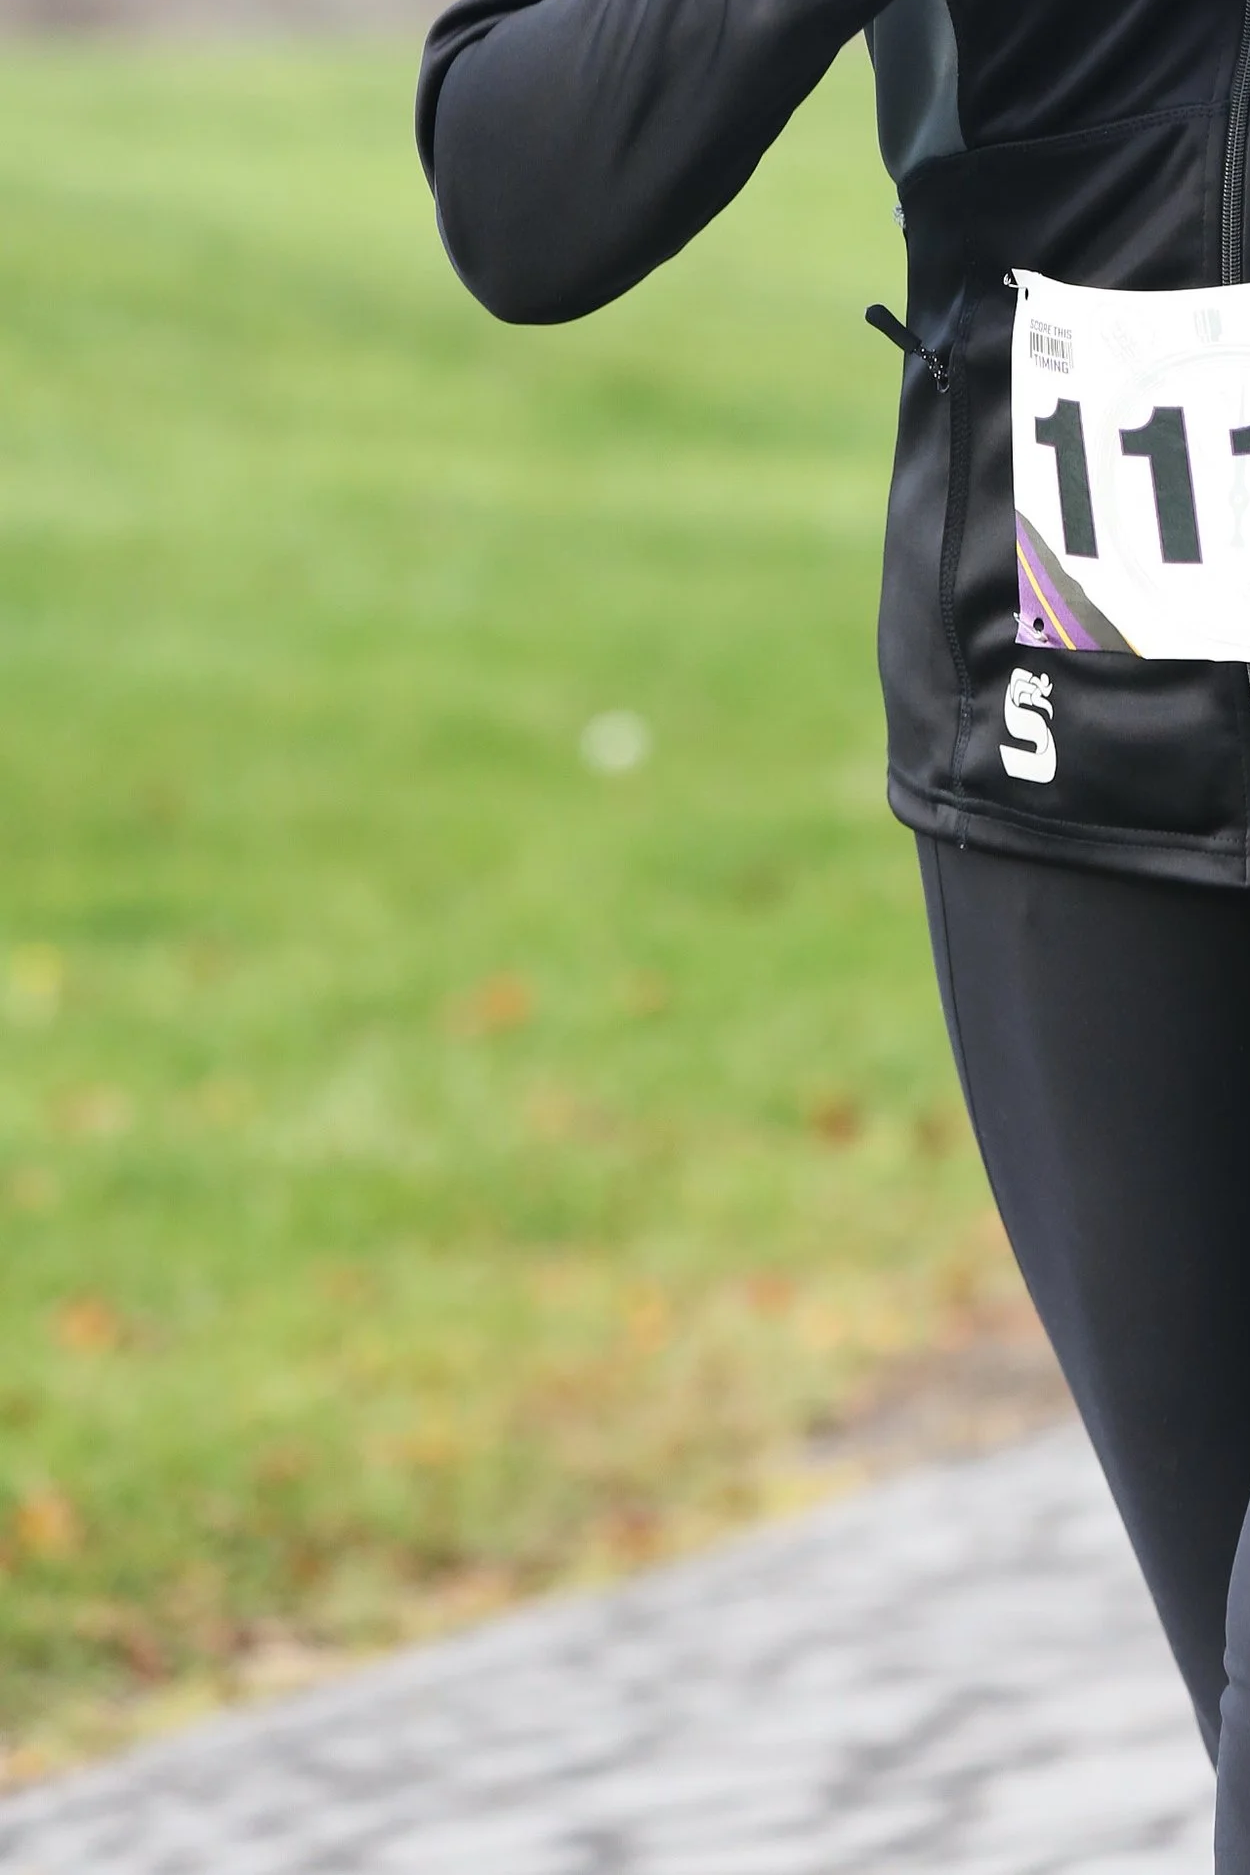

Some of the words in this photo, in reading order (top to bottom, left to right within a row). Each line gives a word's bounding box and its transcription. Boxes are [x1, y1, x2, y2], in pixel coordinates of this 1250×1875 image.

[1030, 319, 1051, 334] SCORE
[1054, 326, 1072, 339] THIS
[1034, 354, 1069, 374] TIMING
